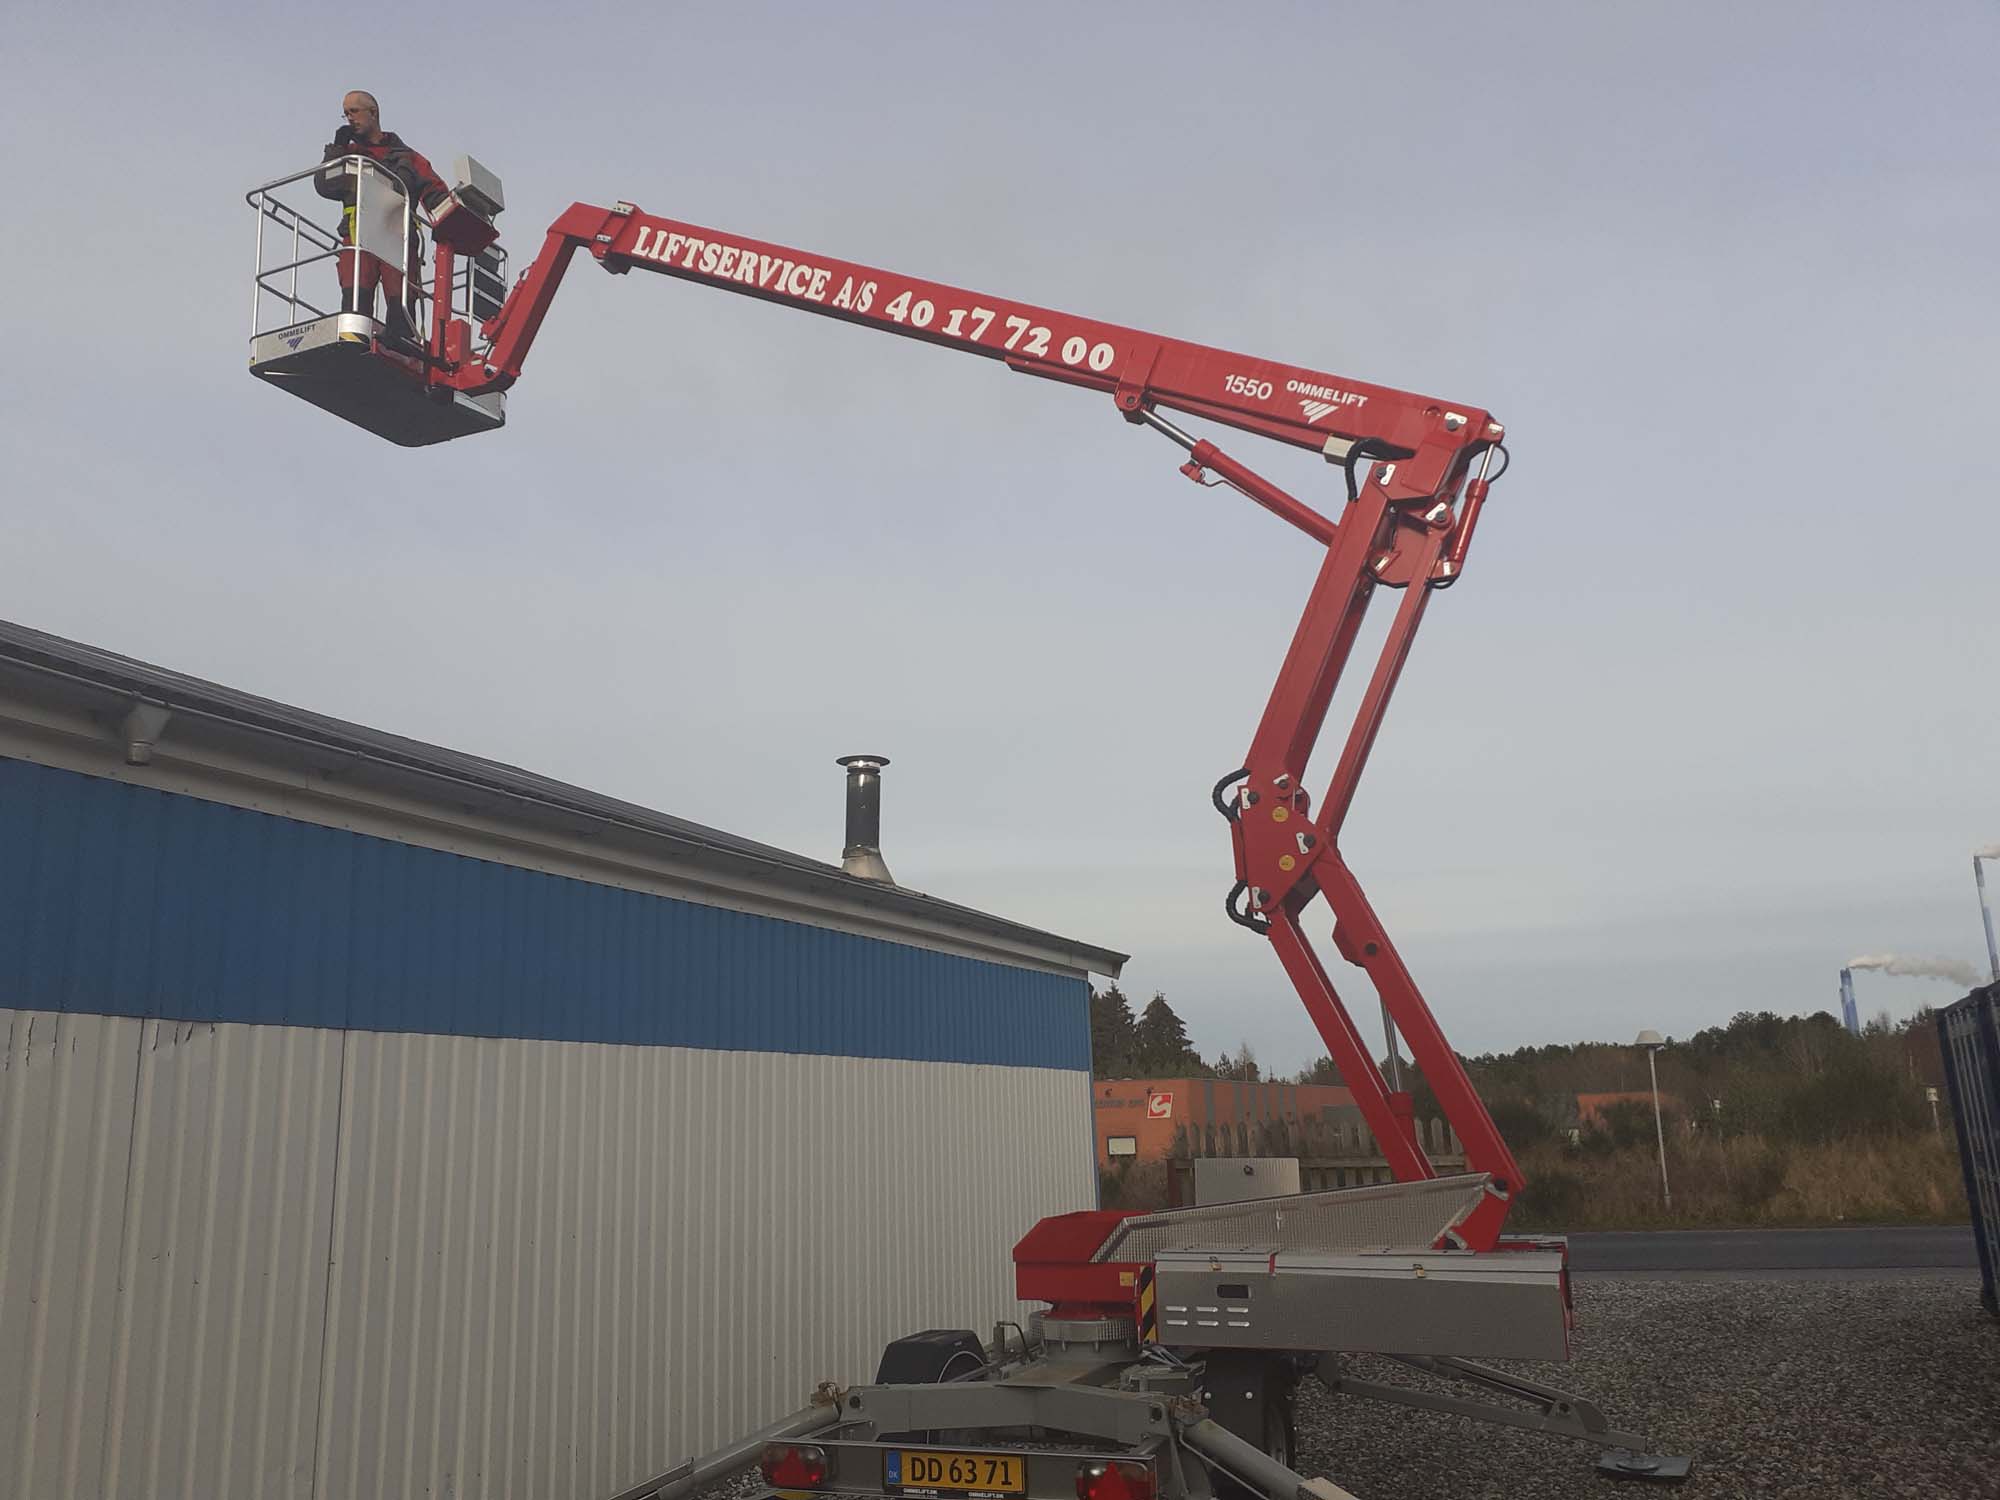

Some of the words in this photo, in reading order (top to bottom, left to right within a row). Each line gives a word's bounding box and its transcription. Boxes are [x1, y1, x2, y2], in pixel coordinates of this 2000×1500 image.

[631, 225, 832, 302] LIFTSERVICE
[832, 276, 878, 313] A/S
[885, 291, 935, 328] 40
[942, 306, 996, 341] 17
[1004, 315, 1052, 357] 72
[1062, 336, 1115, 371] 00
[278, 324, 316, 340] OMMELIFT
[1224, 374, 1273, 400] 1550
[1286, 380, 1369, 408] OMMELIFT
[888, 1470, 898, 1479] DK
[911, 1457, 942, 1482] DD
[949, 1458, 977, 1484] 63
[984, 1460, 1012, 1485] 71
